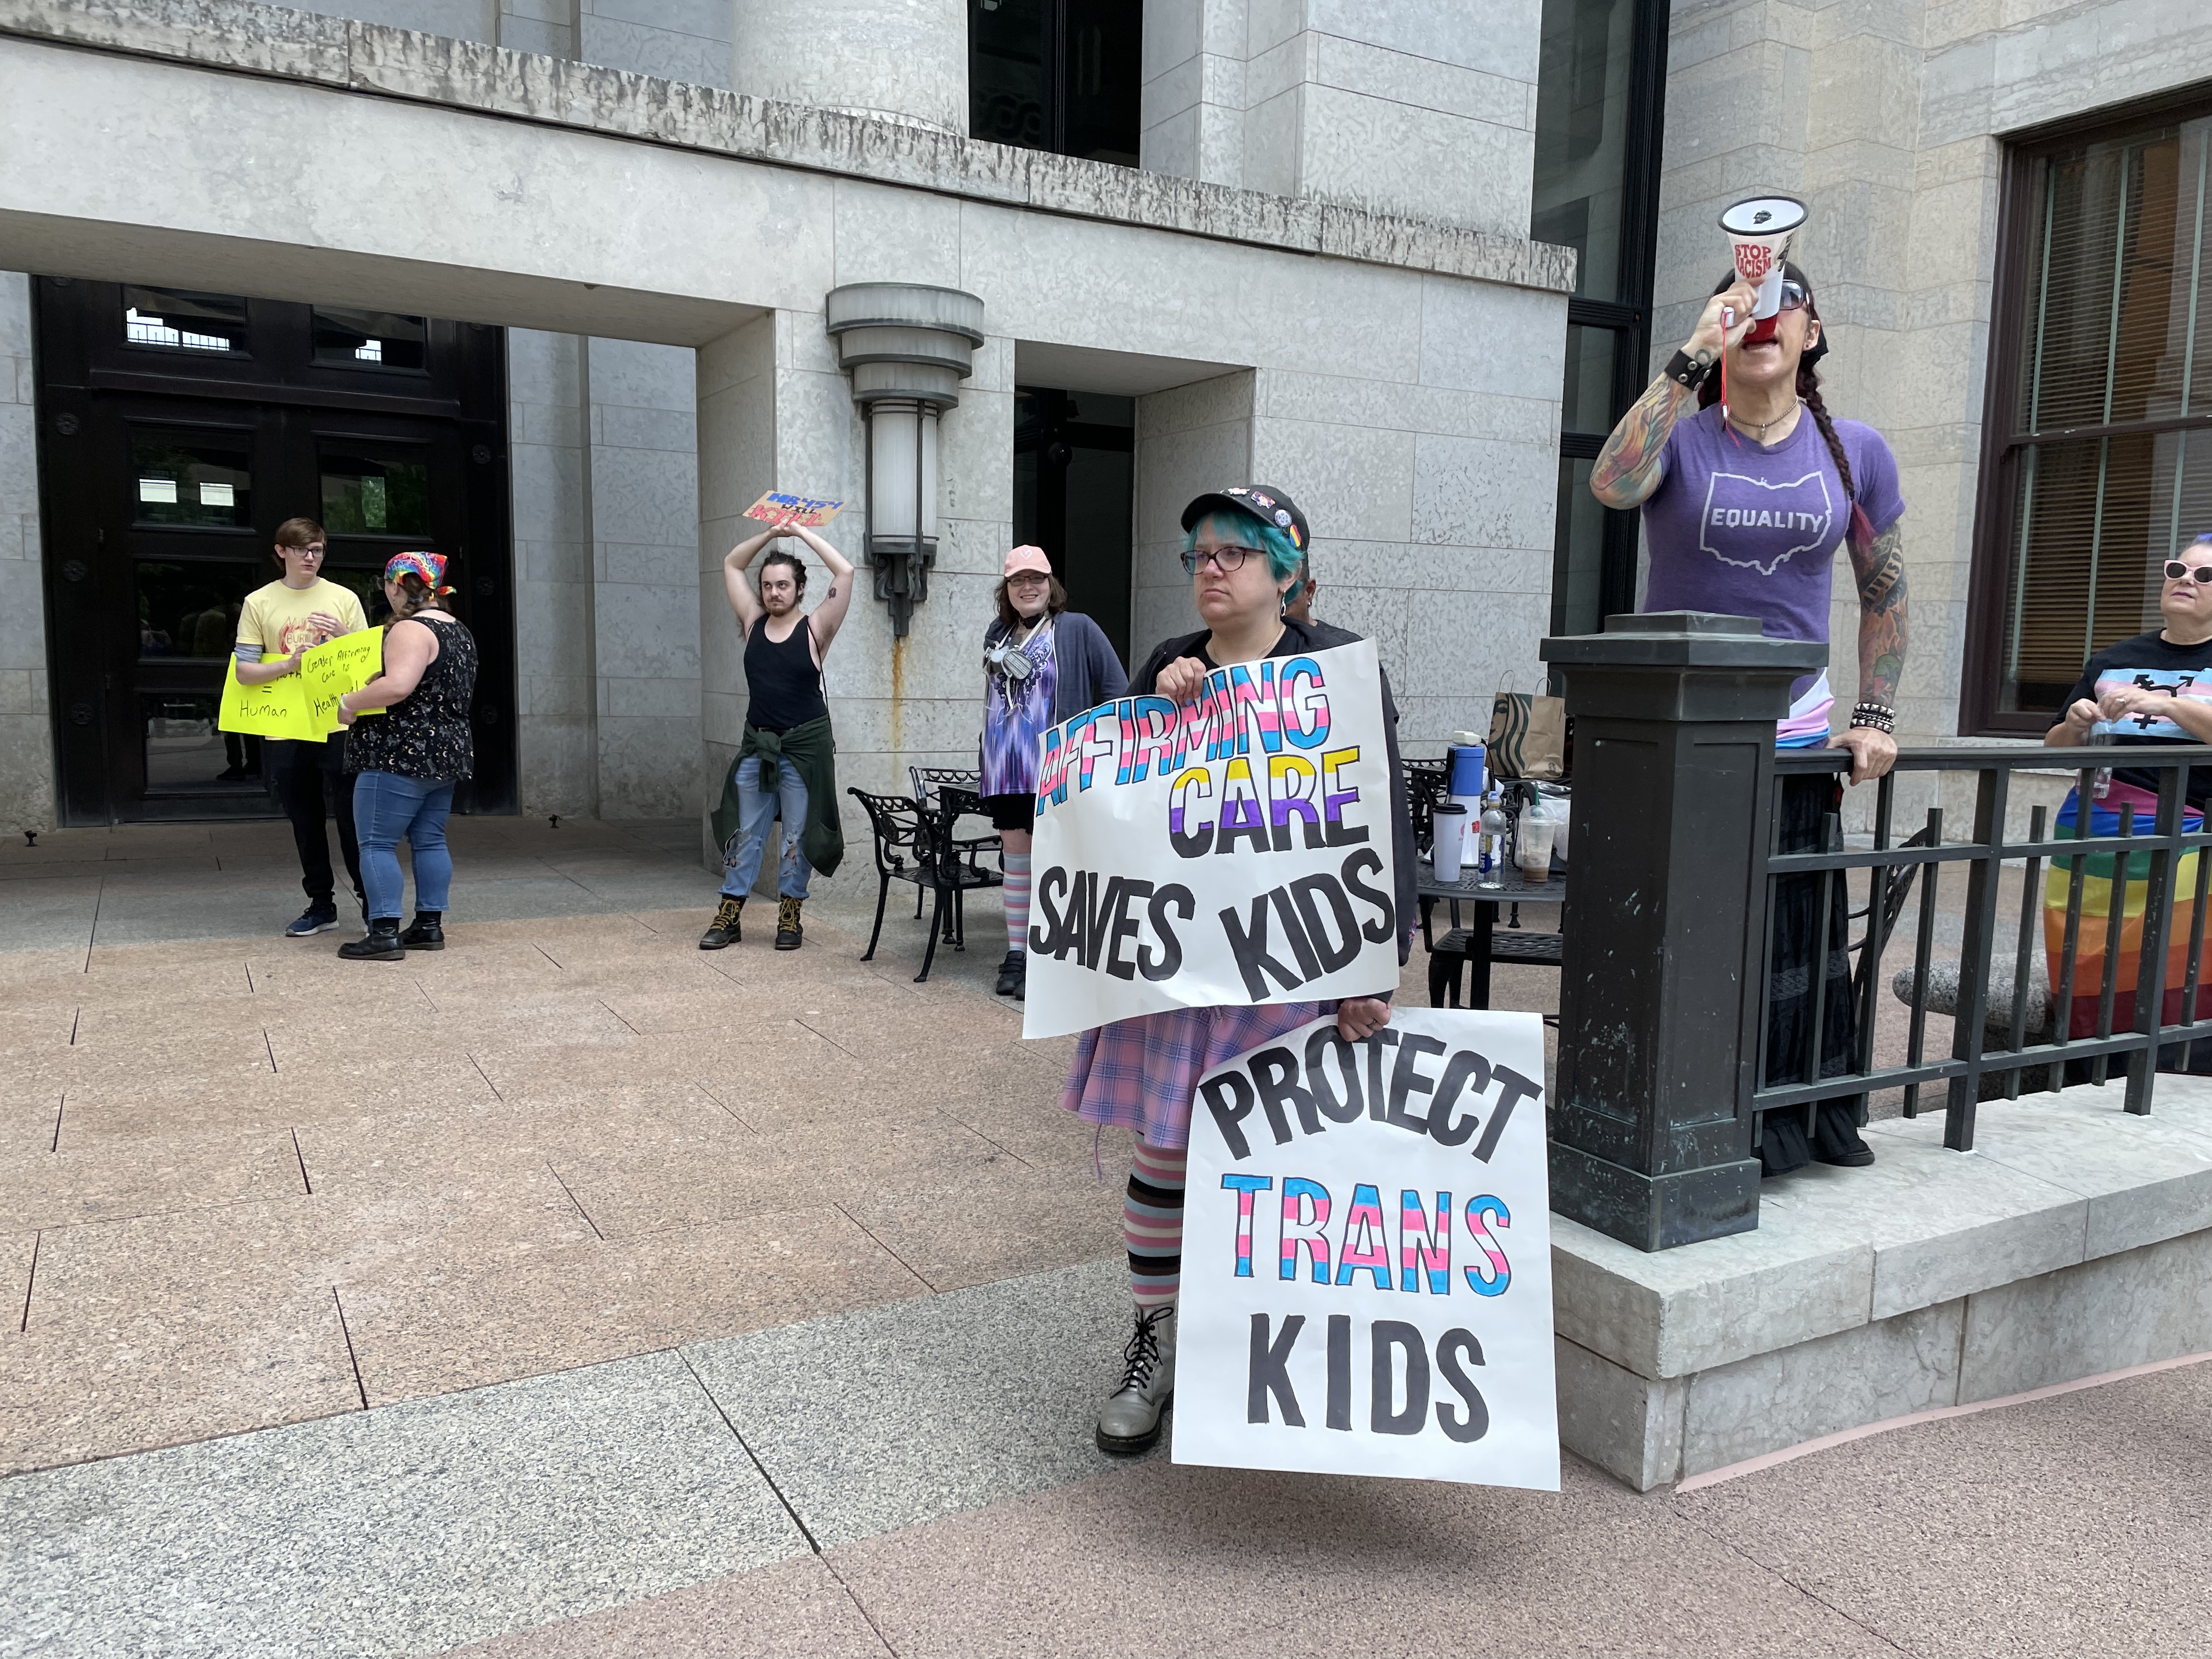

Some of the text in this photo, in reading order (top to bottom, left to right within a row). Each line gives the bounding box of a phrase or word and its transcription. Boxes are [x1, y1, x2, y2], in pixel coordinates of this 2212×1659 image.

[1735, 245, 1771, 259] STOP
[781, 504, 817, 514] WILL
[1711, 508, 1823, 533] EQUALITY
[313, 693, 338, 716] Health
[1036, 657, 1331, 817] AFFIRMING
[1169, 746, 1369, 857] CARE
[1029, 848, 1395, 1003] SAVES KIDS
[1199, 1025, 1544, 1164] PROTECT
[1221, 1173, 1512, 1297] TRANS
[1248, 1313, 1489, 1443] KIDS
